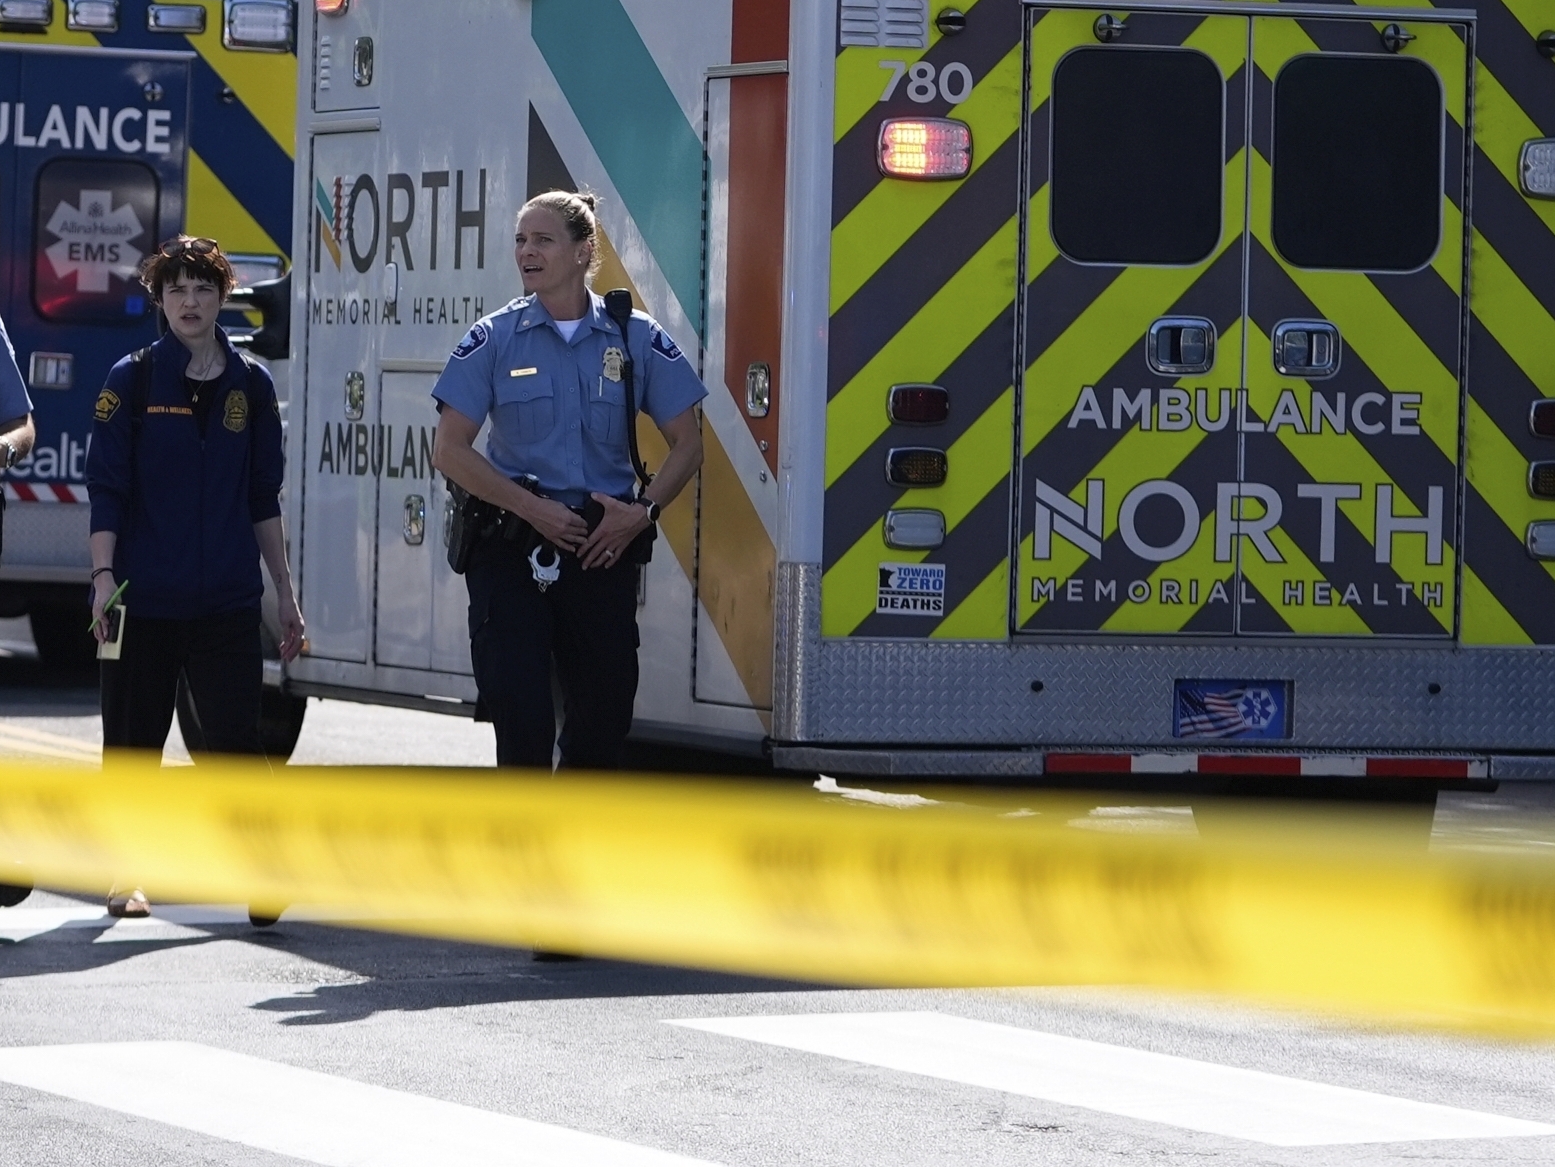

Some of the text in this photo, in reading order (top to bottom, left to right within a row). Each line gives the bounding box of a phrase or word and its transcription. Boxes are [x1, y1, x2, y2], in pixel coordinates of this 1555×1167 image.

[878, 60, 973, 104] 780
[314, 168, 486, 274] NORTH
[68, 241, 120, 262] EMS
[312, 296, 484, 324] MEMORIAL HEALTH
[1067, 386, 1423, 435] AMBULANCE
[318, 421, 436, 480] AMBULAN
[1032, 477, 1445, 566] NORTH
[896, 577, 943, 591] ZERO
[897, 567, 944, 578] TOWARD
[878, 596, 942, 611] DEATHS
[1030, 577, 1444, 607] MEMORIAL HEALTH
